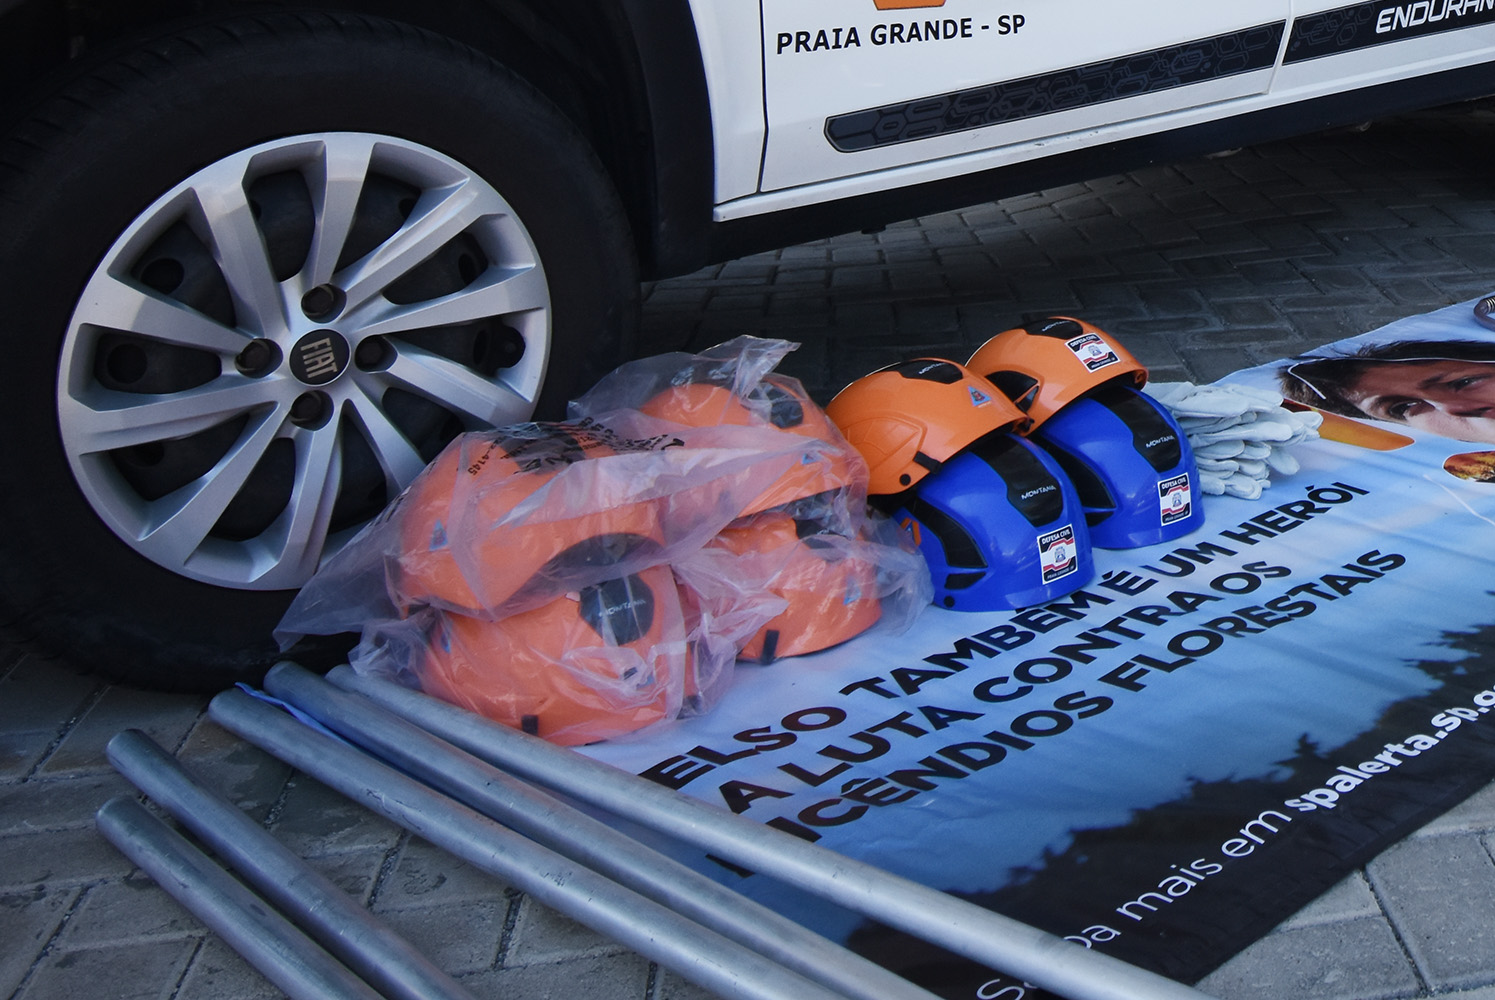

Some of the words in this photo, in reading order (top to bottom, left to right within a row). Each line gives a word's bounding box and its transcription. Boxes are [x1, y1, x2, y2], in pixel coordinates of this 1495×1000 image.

[777, 28, 861, 54] PRAIA
[870, 17, 973, 46] GRANDE
[997, 14, 1026, 35] SP
[300, 337, 338, 379] FIAT
[1145, 434, 1175, 448] MONTANA
[1021, 484, 1056, 500] MONTANA
[1161, 480, 1178, 490] DEFESA
[1178, 477, 1186, 485] CIVIL
[1041, 532, 1060, 545] DEFESA
[1060, 528, 1070, 538] CIVIL
[638, 706, 847, 790] ELSO
[1098, 570, 1159, 597] É
[1140, 542, 1238, 578] UM
[1219, 481, 1371, 545] HERÓI
[1097, 549, 1406, 692] FLORESTAIS
[777, 704, 986, 788] LUTA
[973, 590, 1221, 702] CONTRA
[1209, 560, 1293, 595] OS
[1116, 855, 1225, 921] mais
[1221, 809, 1293, 858] em
